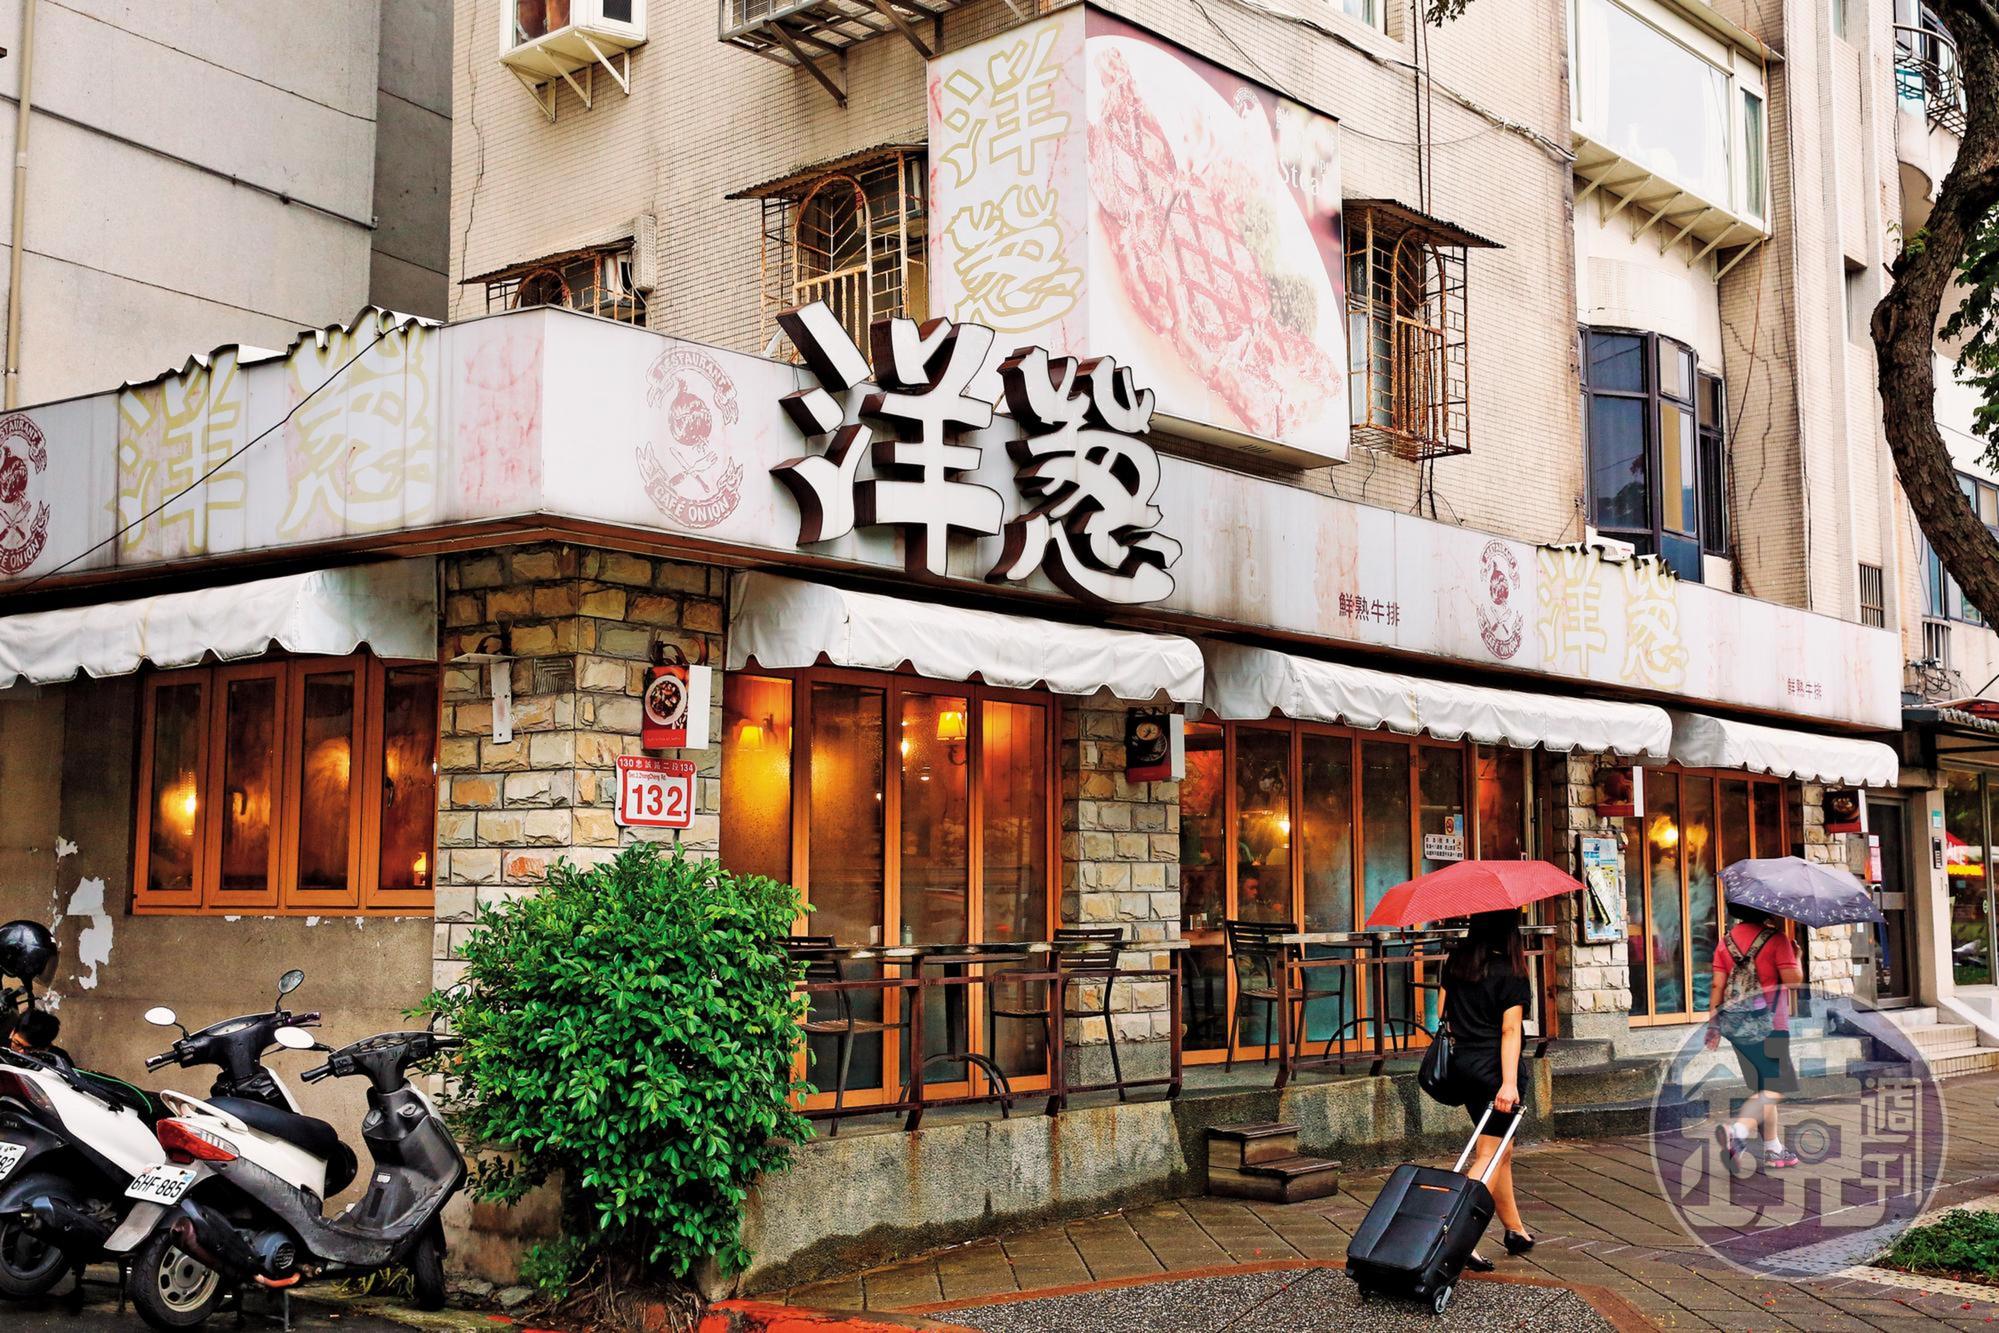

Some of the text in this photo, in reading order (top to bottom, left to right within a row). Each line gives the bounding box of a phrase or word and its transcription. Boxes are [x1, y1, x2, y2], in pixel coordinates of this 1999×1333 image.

[658, 351, 729, 389] RESTAURANT
[688, 497, 730, 522] ONION
[10, 538, 40, 569] ONION
[1339, 592, 1400, 627] 鮮熟牛排
[680, 763, 694, 772] 134
[632, 784, 683, 817] 132
[131, 1174, 186, 1199] 6HF-885
